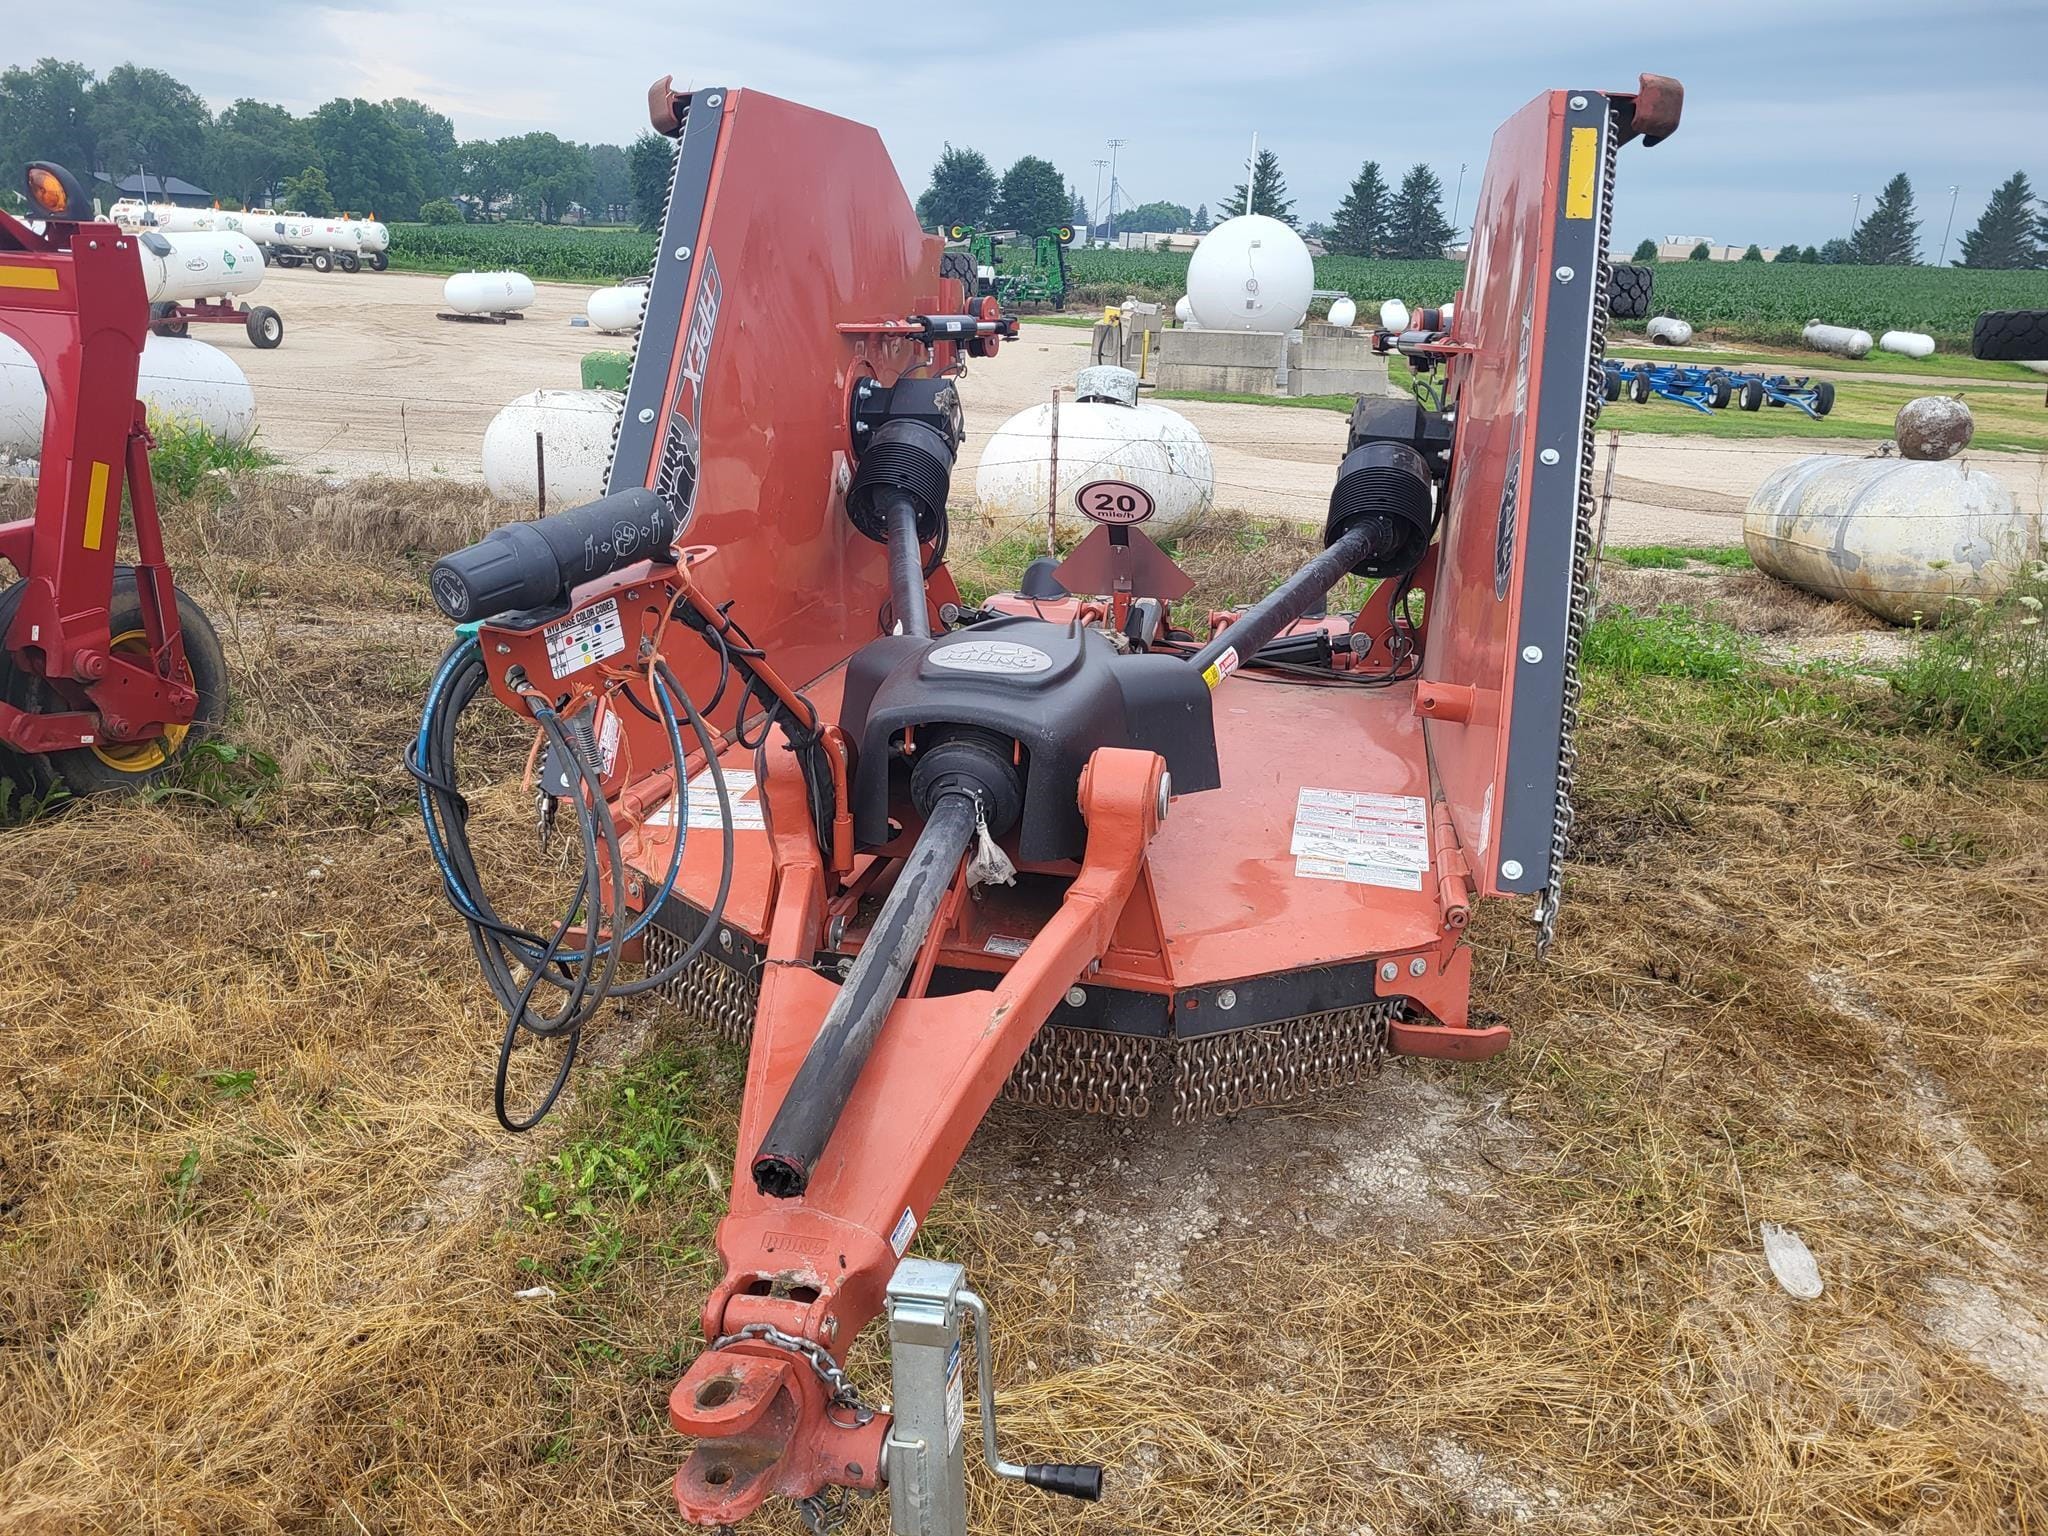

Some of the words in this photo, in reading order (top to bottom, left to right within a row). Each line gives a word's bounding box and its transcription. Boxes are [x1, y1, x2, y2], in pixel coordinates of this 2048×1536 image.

[1094, 493, 1136, 512] 20
[1097, 511, 1135, 519] mile/h
[560, 616, 576, 629] HOSE
[575, 608, 595, 623] COLOR
[595, 599, 614, 616] CODES
